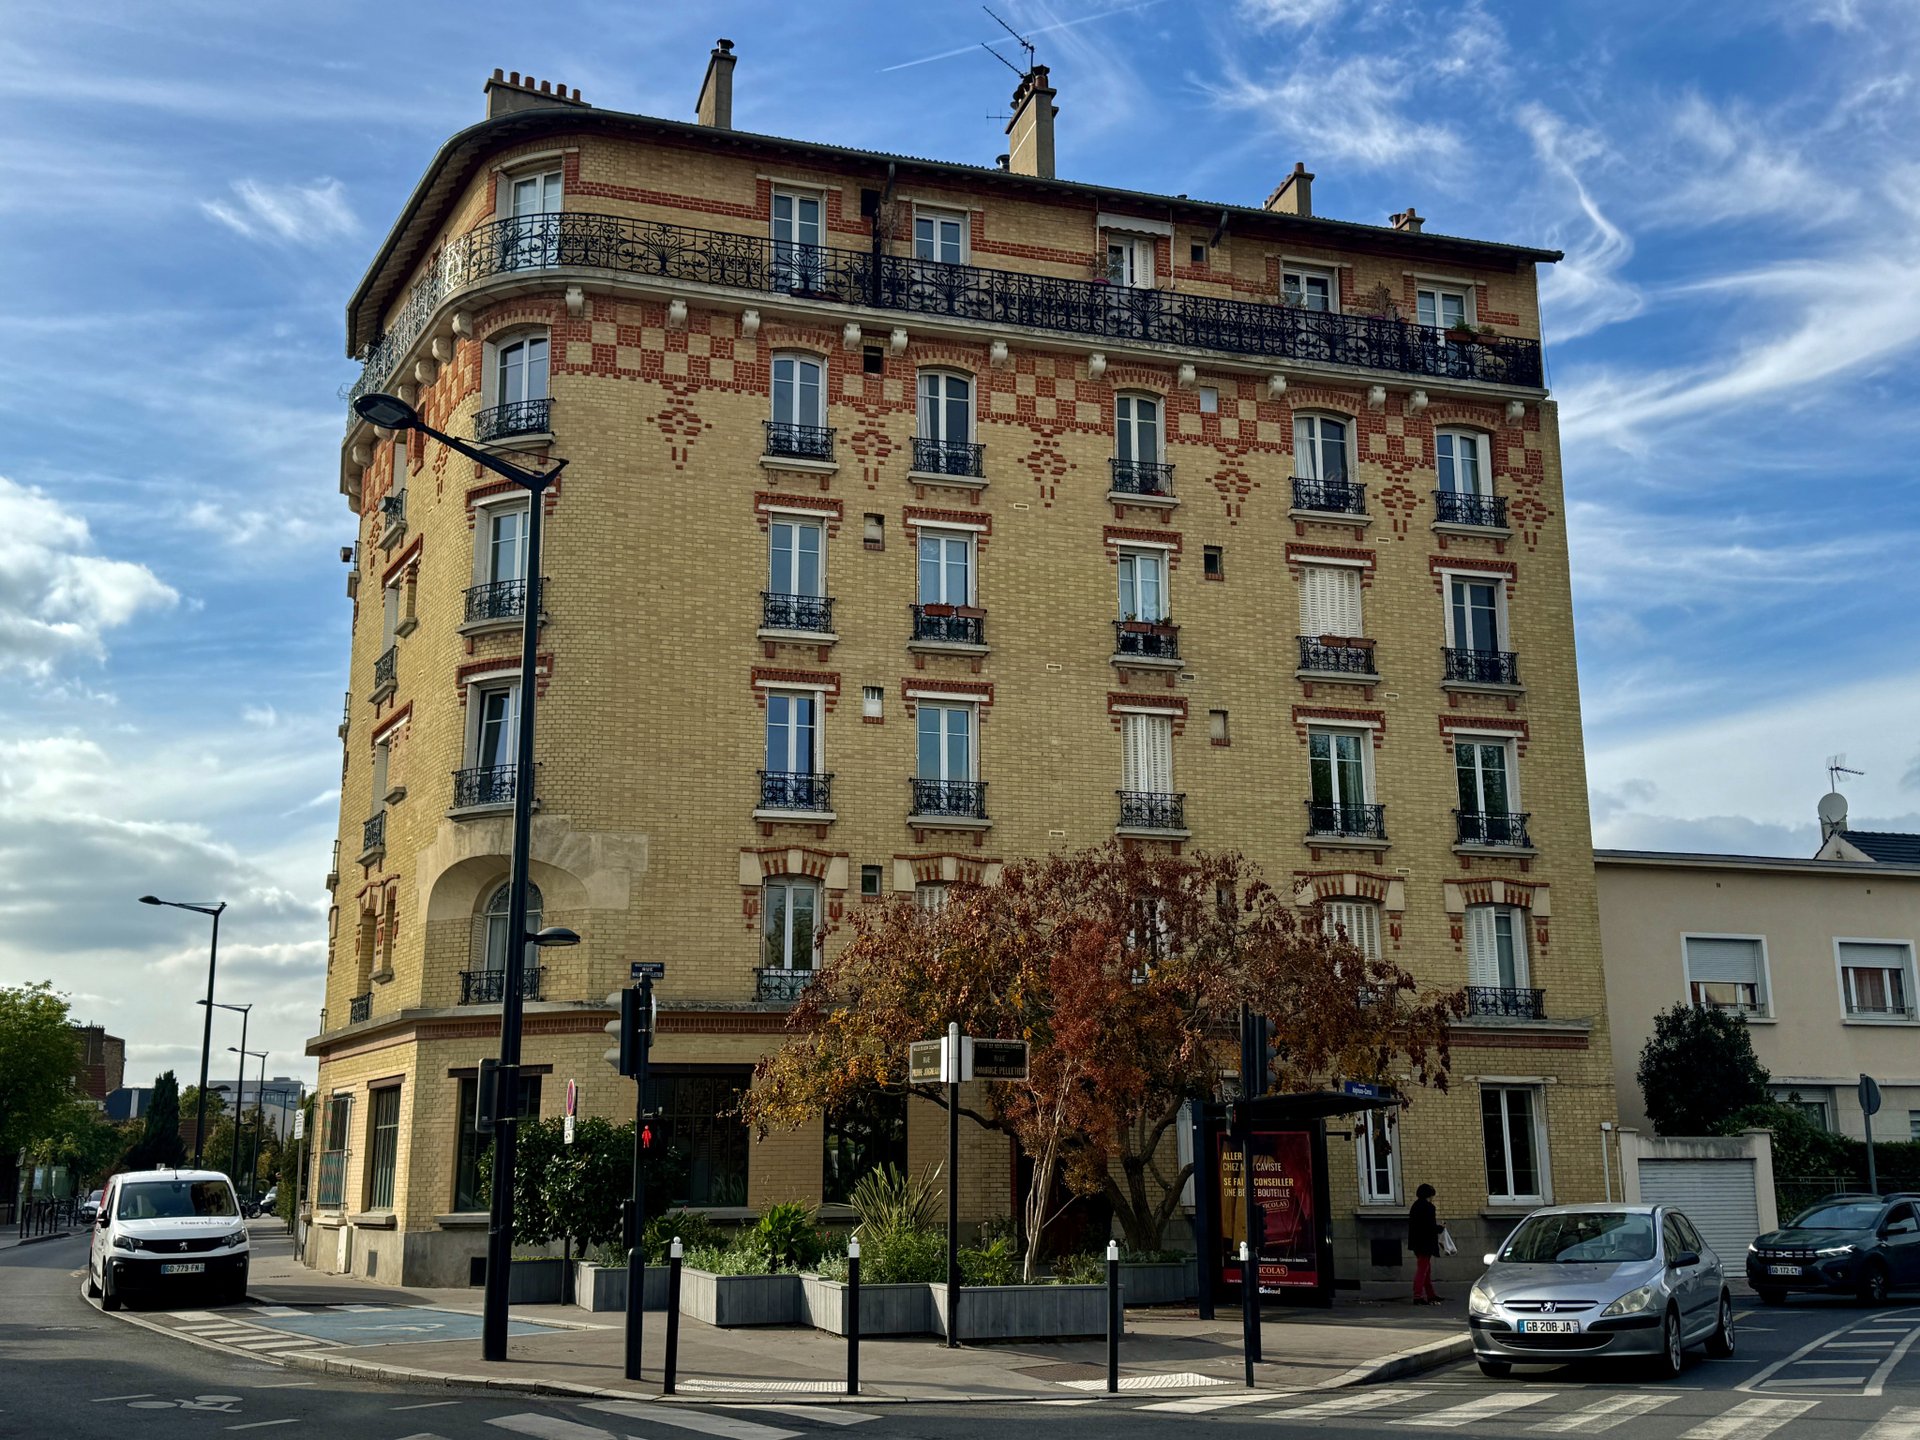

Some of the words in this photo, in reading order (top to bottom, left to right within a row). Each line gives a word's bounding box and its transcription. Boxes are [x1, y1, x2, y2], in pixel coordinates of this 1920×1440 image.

[975, 1066, 997, 1075] MAURICE
[999, 1066, 1025, 1076] PELLETIER
[1222, 1152, 1243, 1161] ALLER
[1222, 1163, 1239, 1172] CHEZ
[1255, 1162, 1282, 1172] CAVISTE
[1223, 1177, 1232, 1186] SE
[1253, 1178, 1294, 1187] CONSEILLER
[1224, 1188, 1237, 1197] UNE
[1257, 1188, 1290, 1198] BOUTEILLE
[1258, 1266, 1285, 1275] ICOLAS
